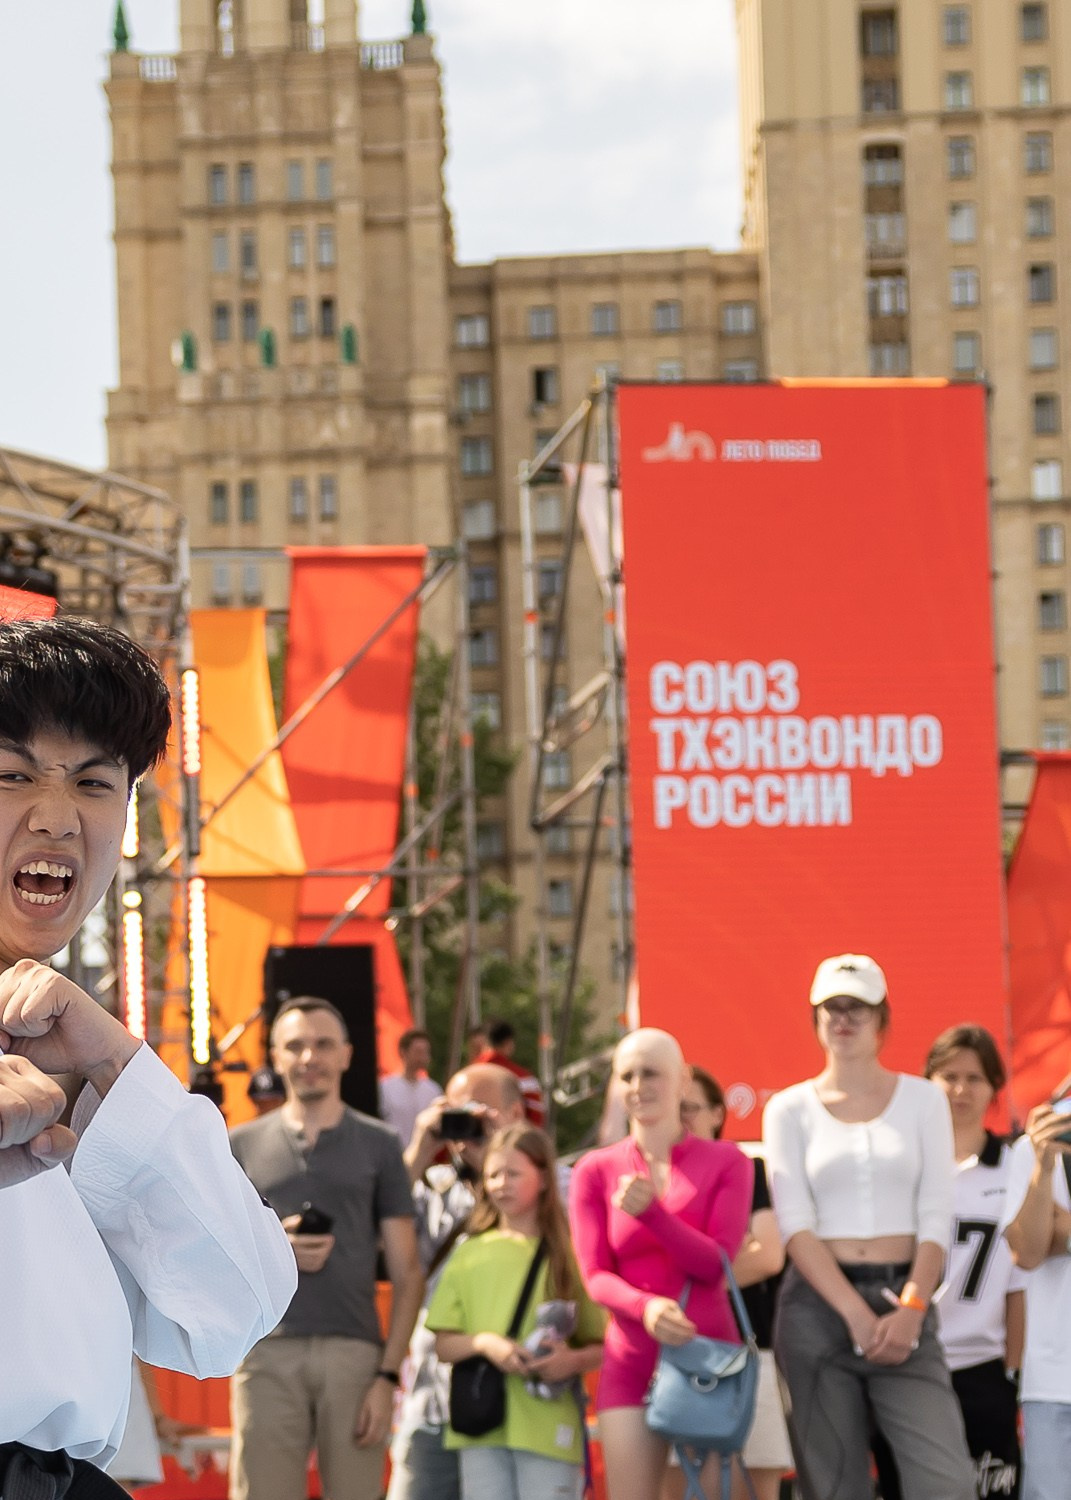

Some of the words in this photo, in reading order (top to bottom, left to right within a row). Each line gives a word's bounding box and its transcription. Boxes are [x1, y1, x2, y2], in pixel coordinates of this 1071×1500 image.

[650, 660, 799, 714] СОЮЗ
[650, 714, 942, 777] ТХЭКВОНДО
[654, 772, 852, 829] РОССИИ
[954, 1216, 1000, 1302] 7
